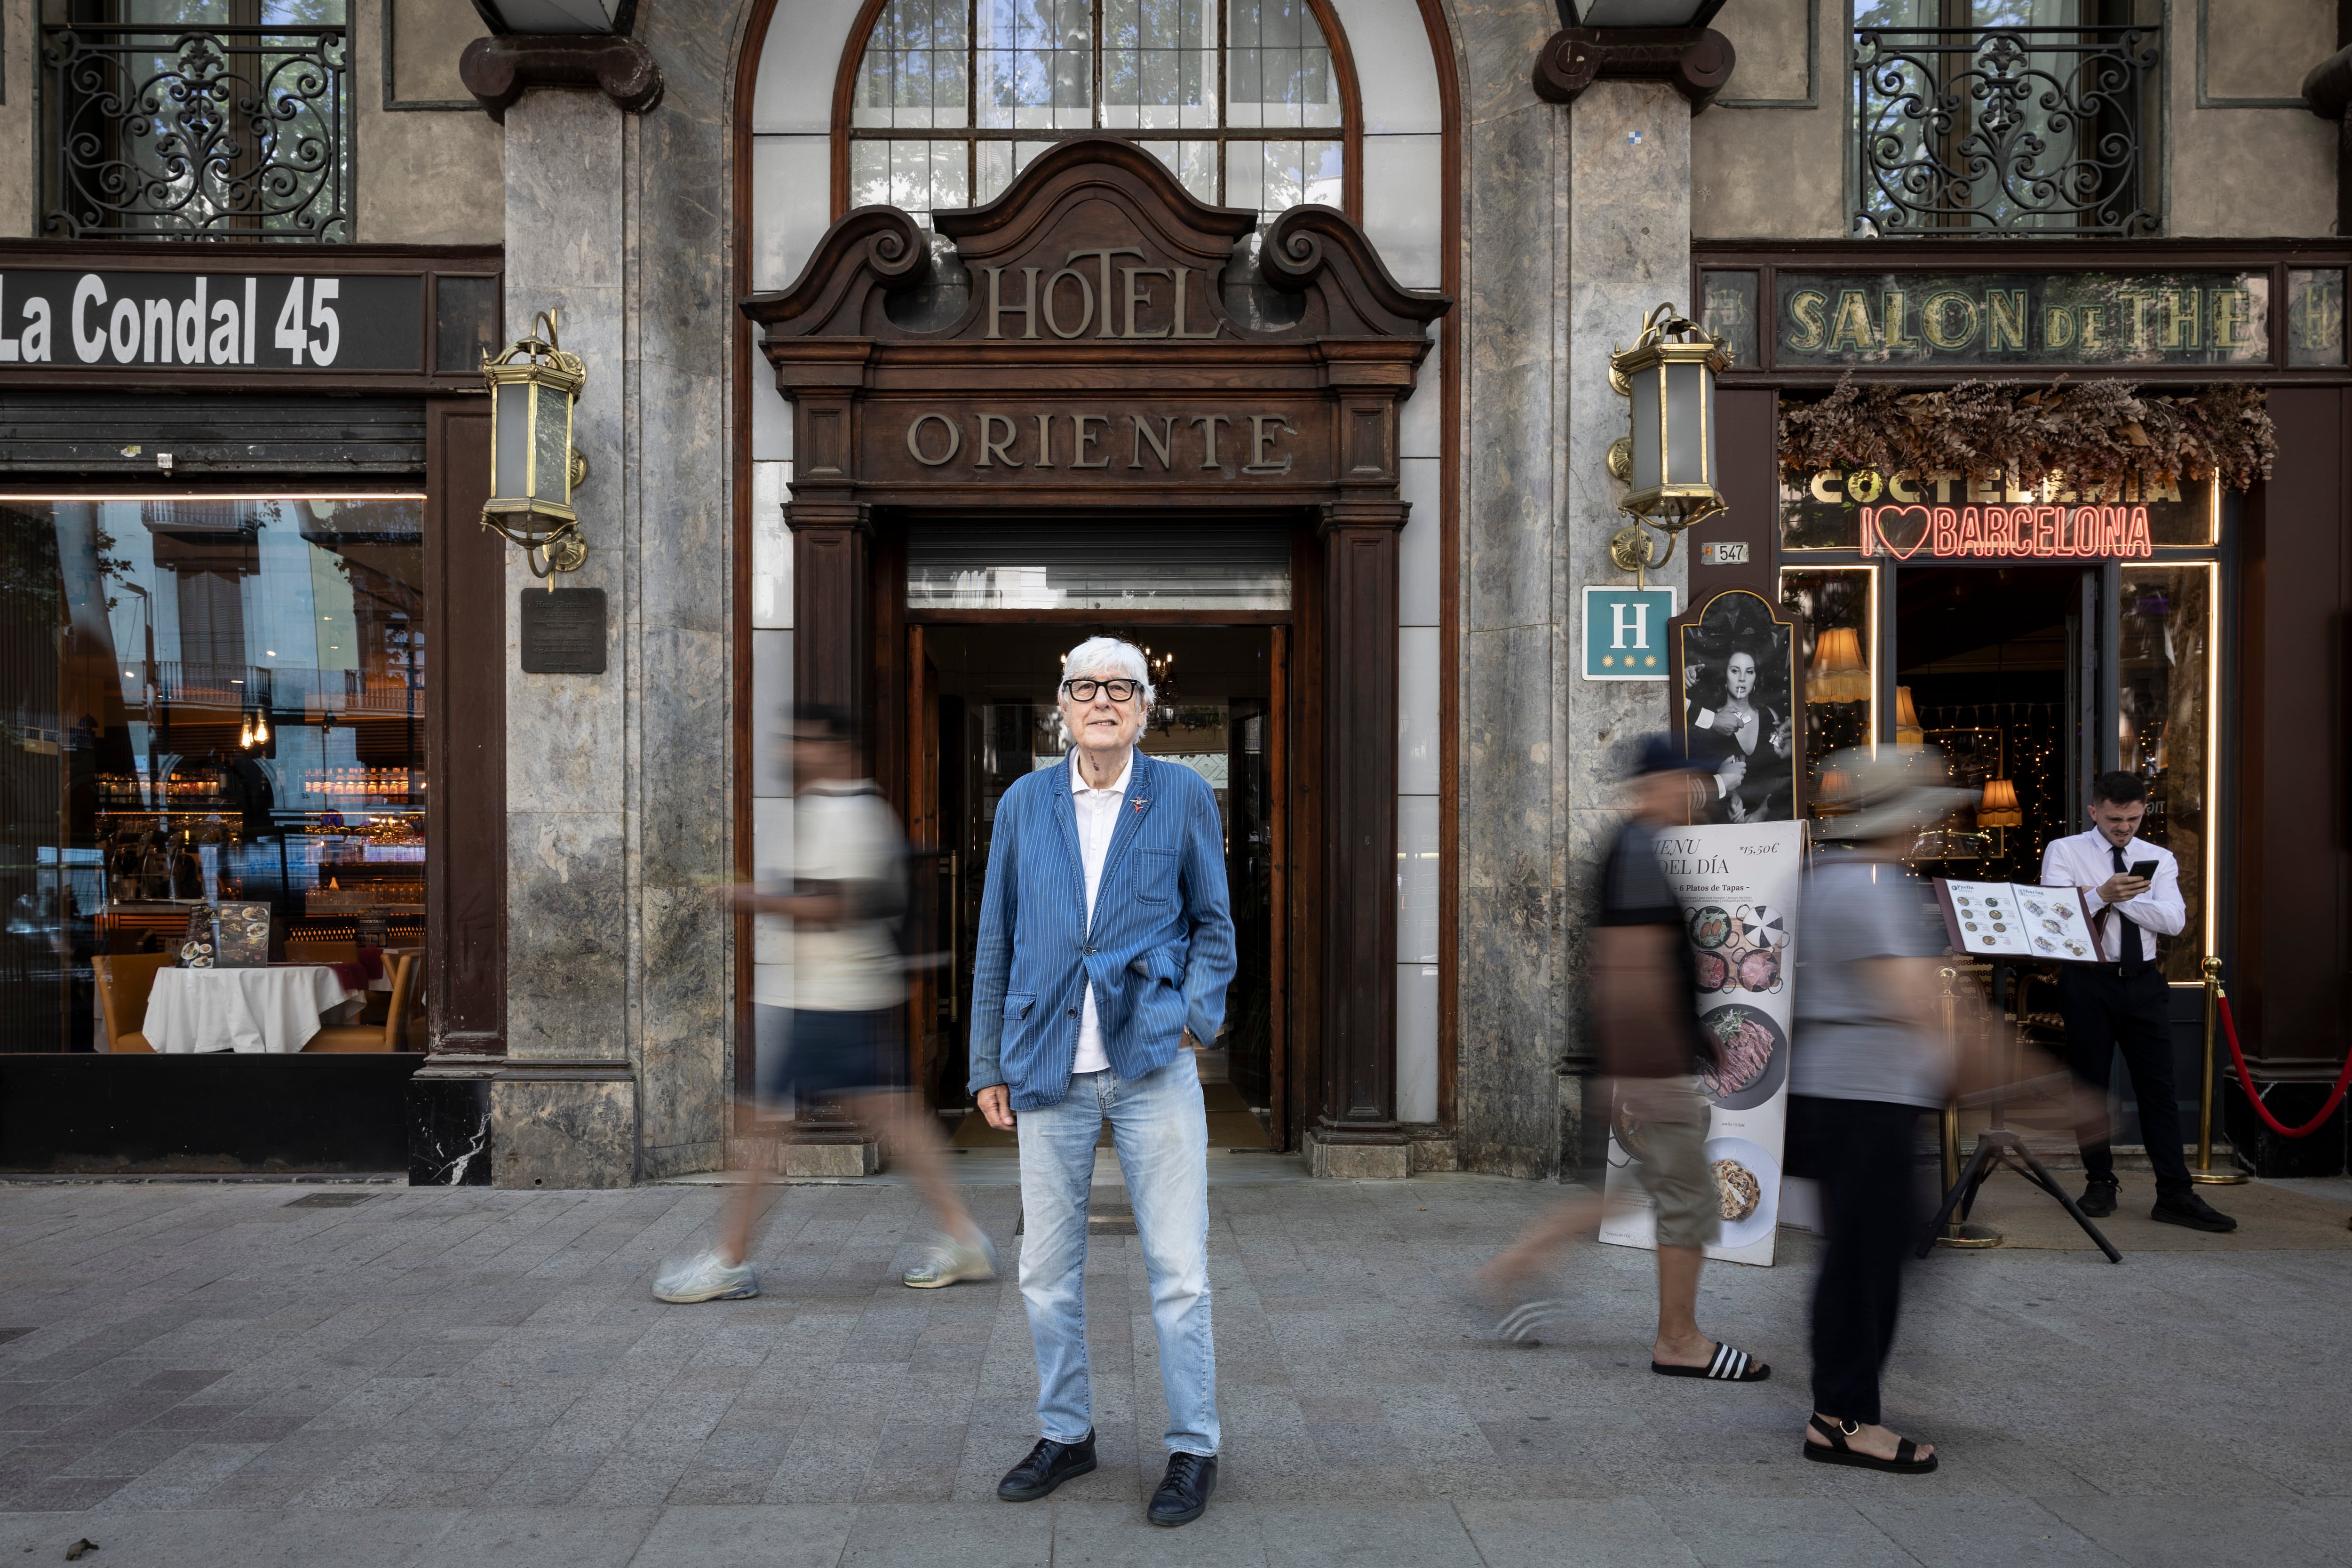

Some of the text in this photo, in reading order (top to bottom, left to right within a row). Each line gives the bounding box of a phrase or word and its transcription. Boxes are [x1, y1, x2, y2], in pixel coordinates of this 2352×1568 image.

[72, 273, 256, 365] Condal
[275, 276, 339, 366] 45
[984, 247, 1222, 340] HOTEL
[1788, 288, 2028, 352] SALON
[2044, 304, 2106, 351] DE
[2114, 288, 2251, 352] THE
[907, 413, 1291, 469] ORIENTE
[1720, 545, 1744, 560] 547
[1933, 506, 2153, 558] BARCELONA
[1610, 604, 1650, 649] H
[1696, 855, 1729, 874] DÍA
